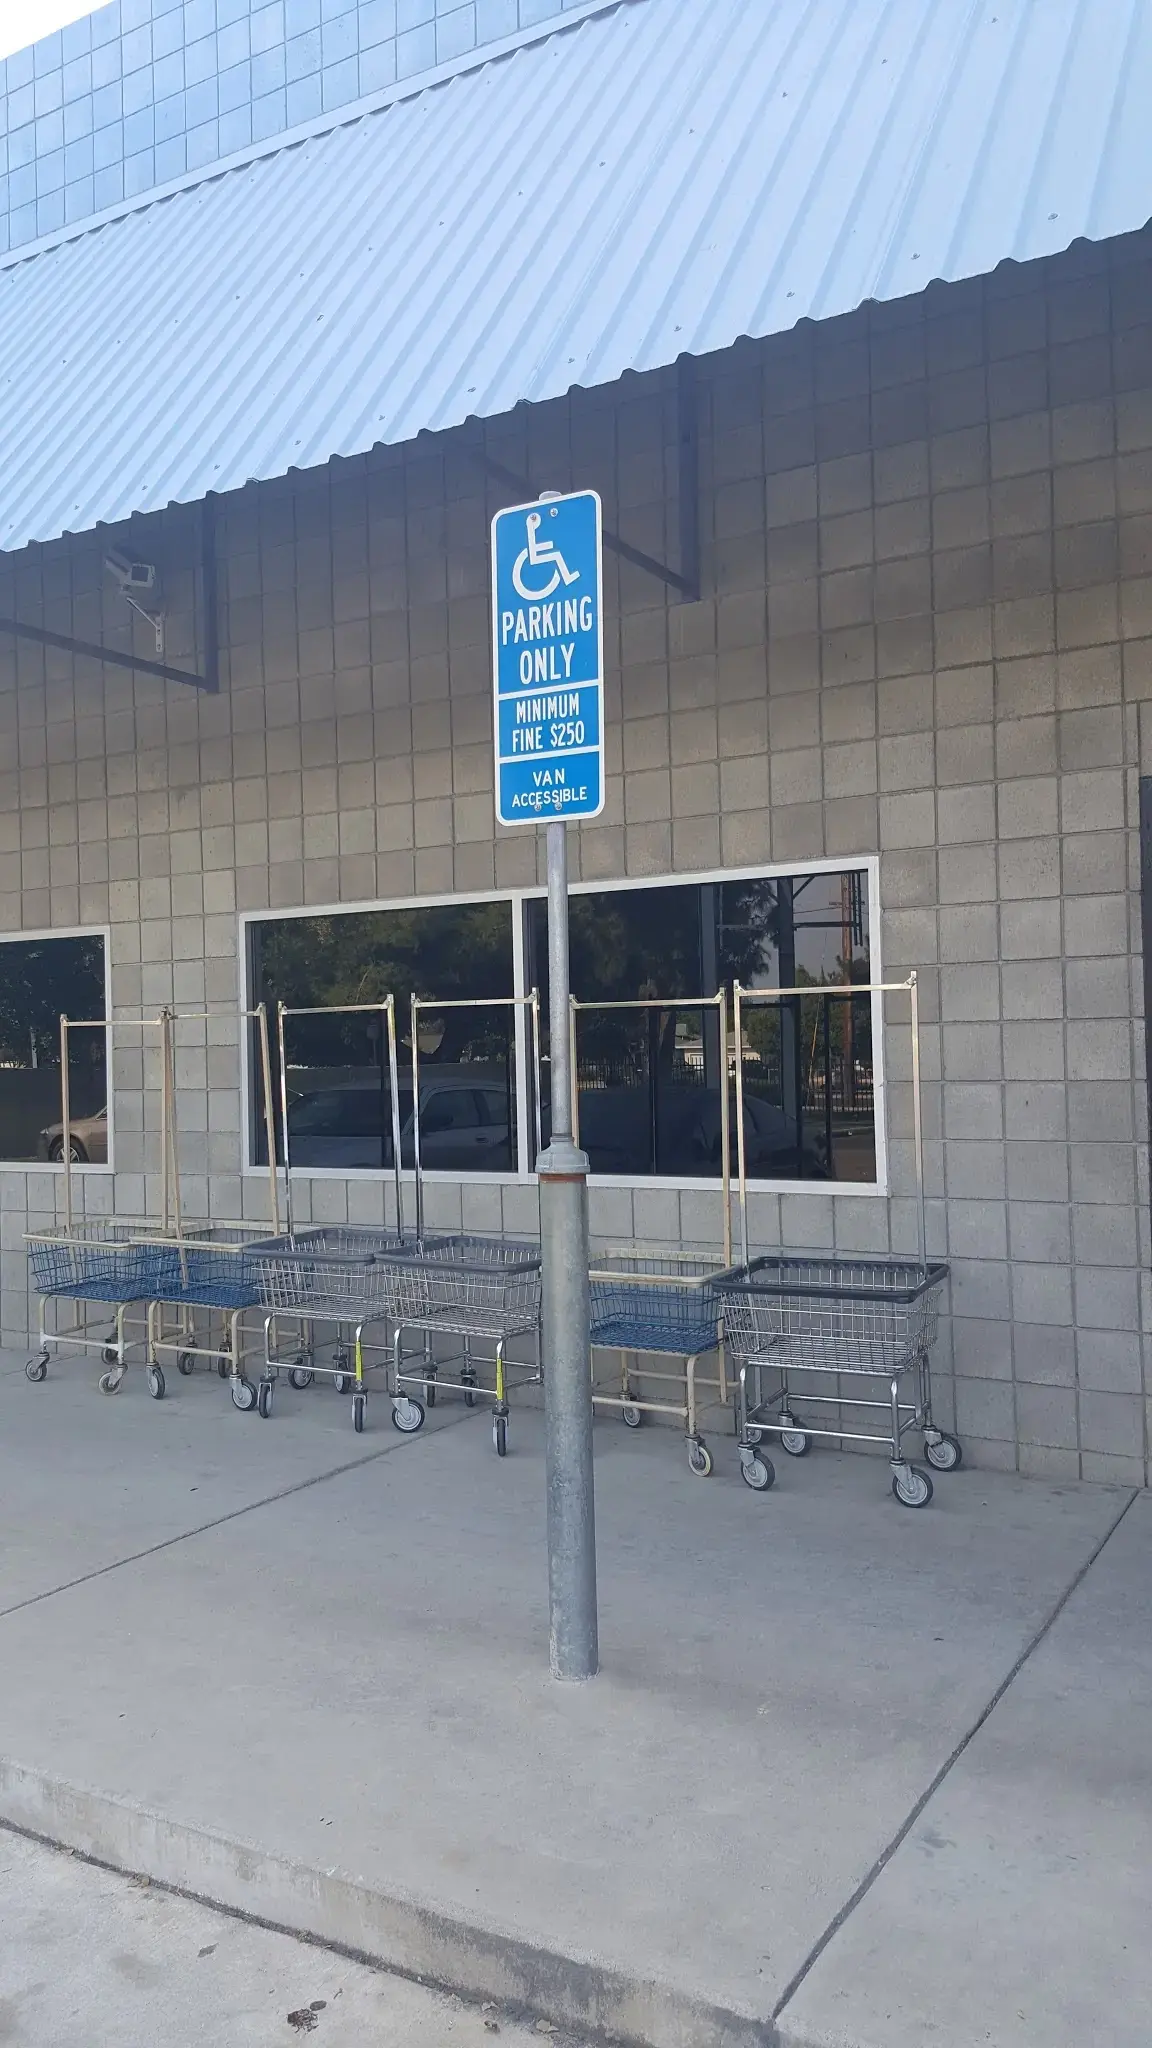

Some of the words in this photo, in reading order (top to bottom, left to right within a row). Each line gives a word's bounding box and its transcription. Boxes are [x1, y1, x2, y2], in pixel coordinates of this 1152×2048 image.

[502, 596, 592, 646] PARKING
[519, 643, 575, 685] ONLY
[516, 692, 579, 724] MINIMUM
[512, 726, 543, 753] FINE
[550, 720, 585, 748] $250
[533, 768, 565, 787] VAN
[511, 786, 587, 808] ACCESSIBLE
